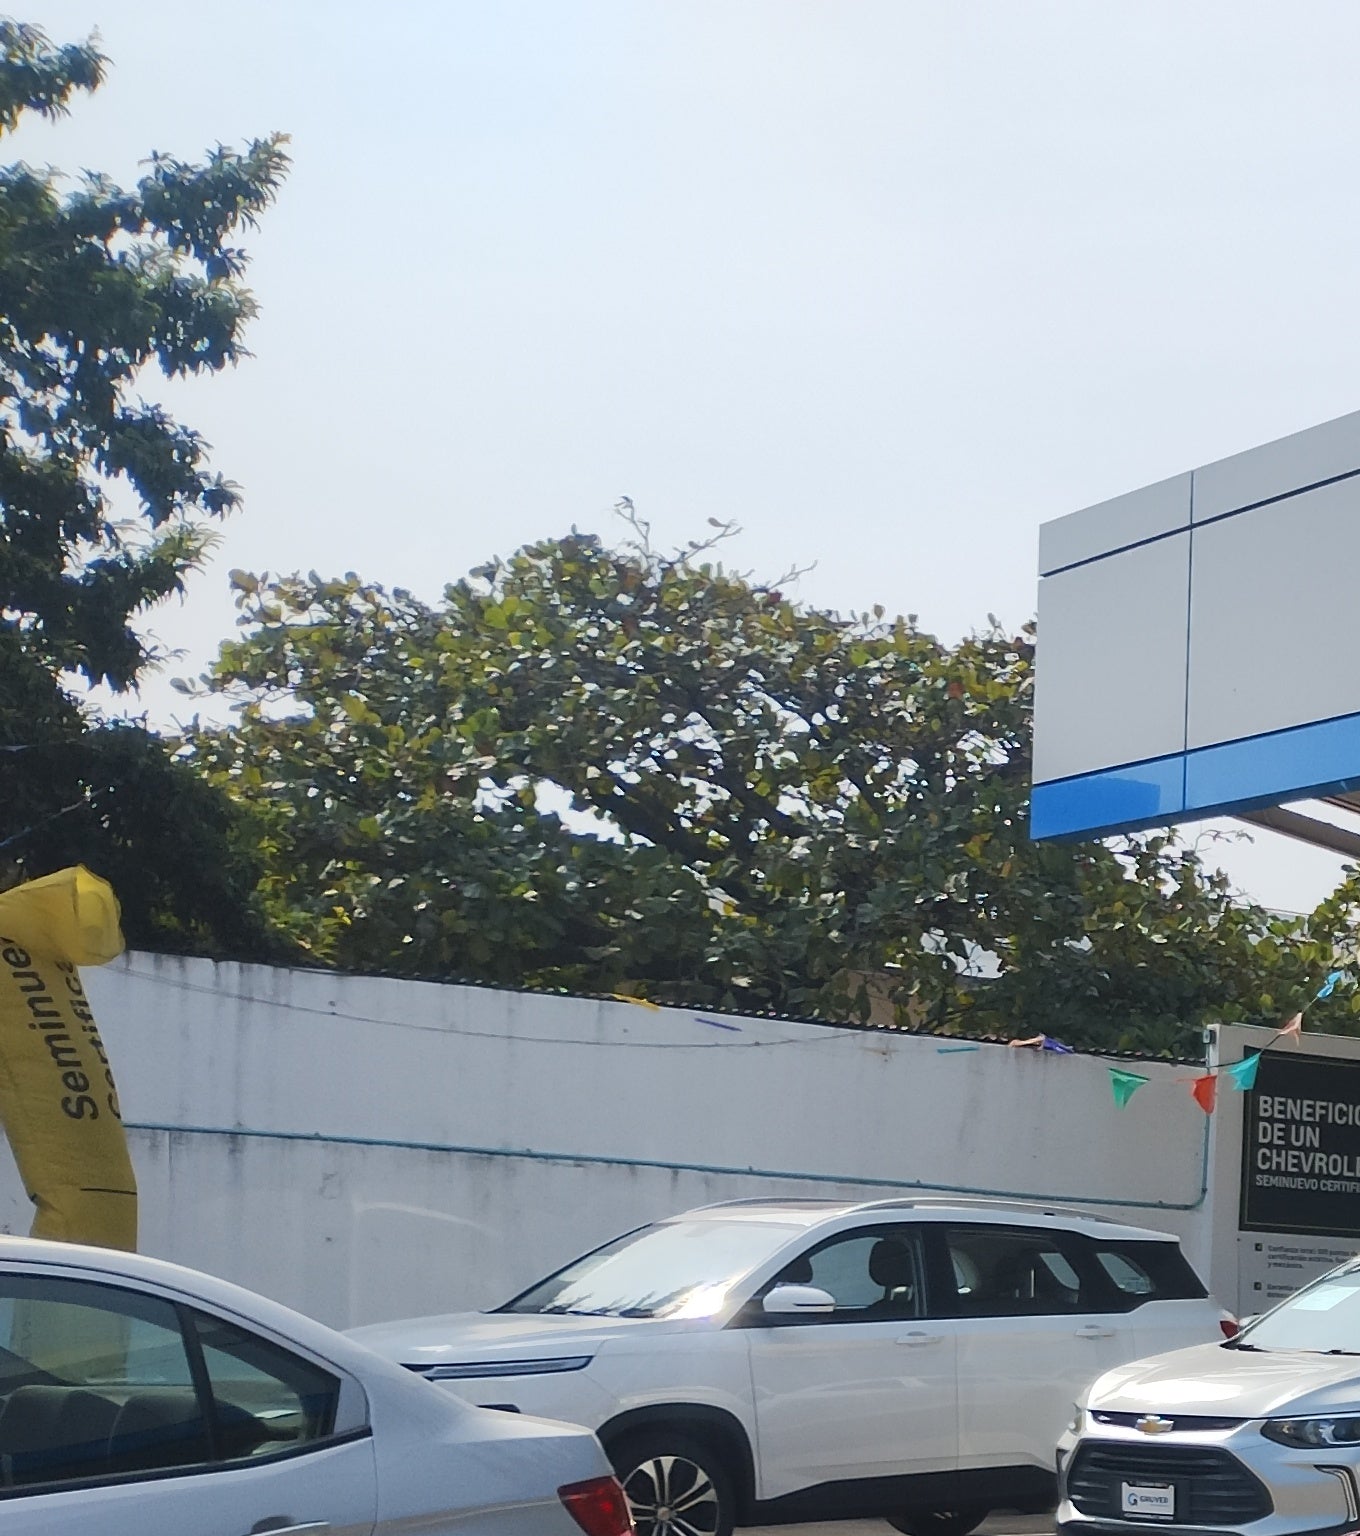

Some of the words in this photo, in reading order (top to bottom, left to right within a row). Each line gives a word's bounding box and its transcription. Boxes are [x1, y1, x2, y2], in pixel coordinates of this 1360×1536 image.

[0, 936, 100, 1121] Seminue
[1258, 1121, 1286, 1145] DE
[1290, 1124, 1320, 1148] UN
[1256, 1174, 1319, 1190] SEMINUEVO
